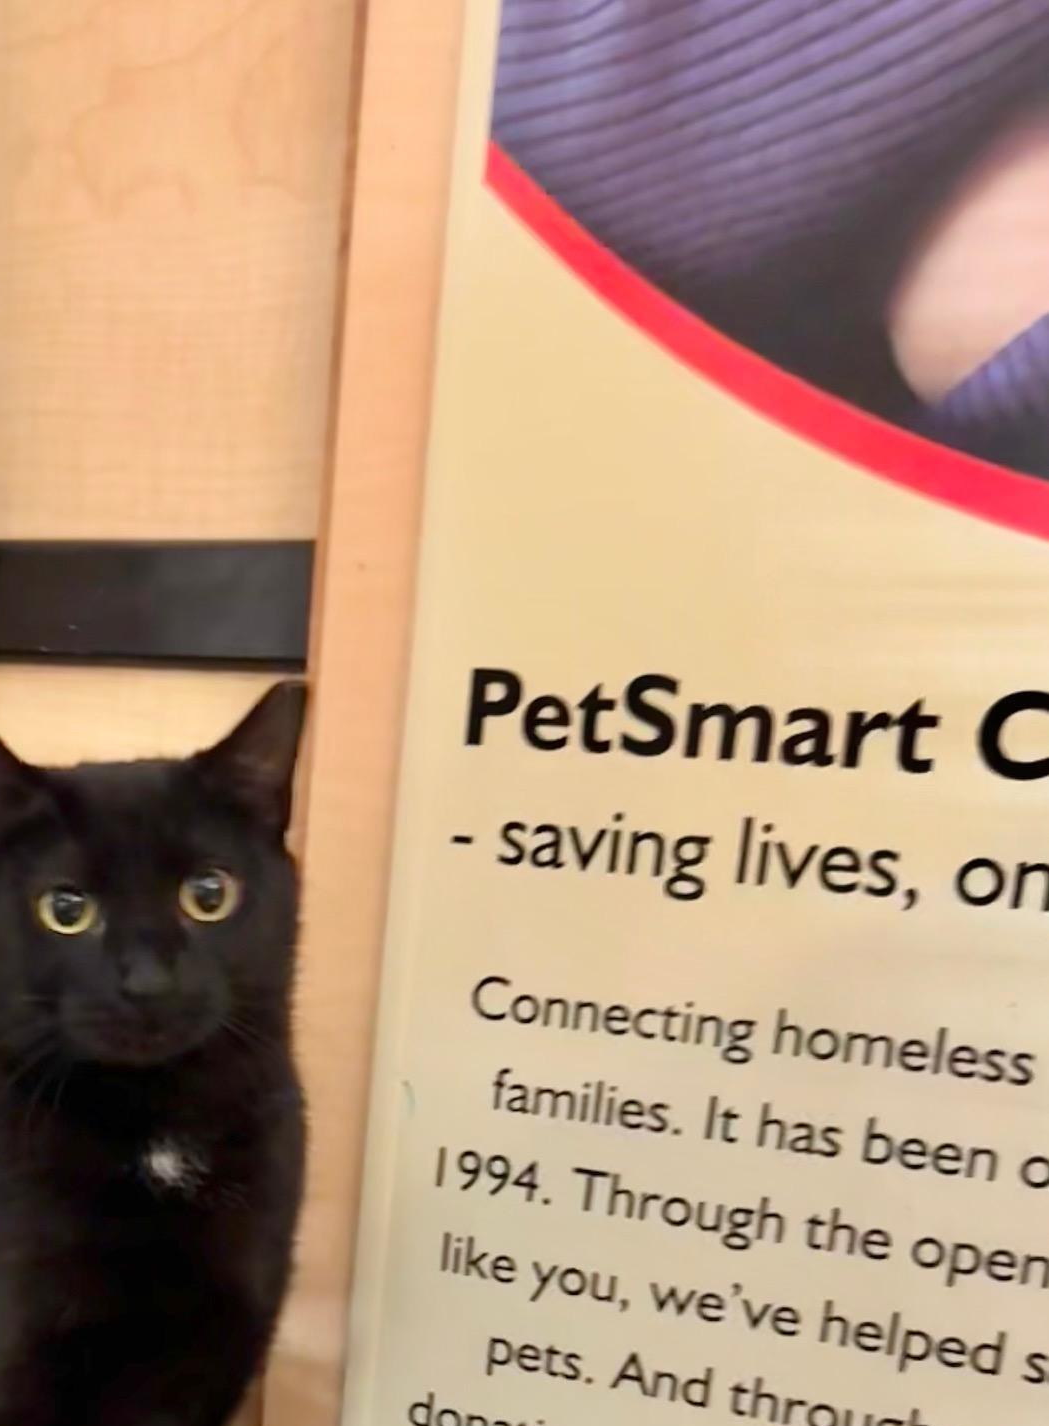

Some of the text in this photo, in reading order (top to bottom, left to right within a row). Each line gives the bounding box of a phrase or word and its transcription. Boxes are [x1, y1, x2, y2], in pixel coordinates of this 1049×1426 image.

[464, 667, 943, 774] PetSmart
[496, 812, 713, 901] saving
[735, 816, 919, 911] lives,
[954, 857, 1049, 912] on
[471, 976, 1036, 1086] Connecting homeless
[493, 1068, 1049, 1189] families. It has been o
[435, 1147, 1049, 1289] 1994. Through the open
[441, 1232, 1049, 1384] like you, we've helped s
[486, 1337, 594, 1384] pets.
[609, 1352, 714, 1408] And
